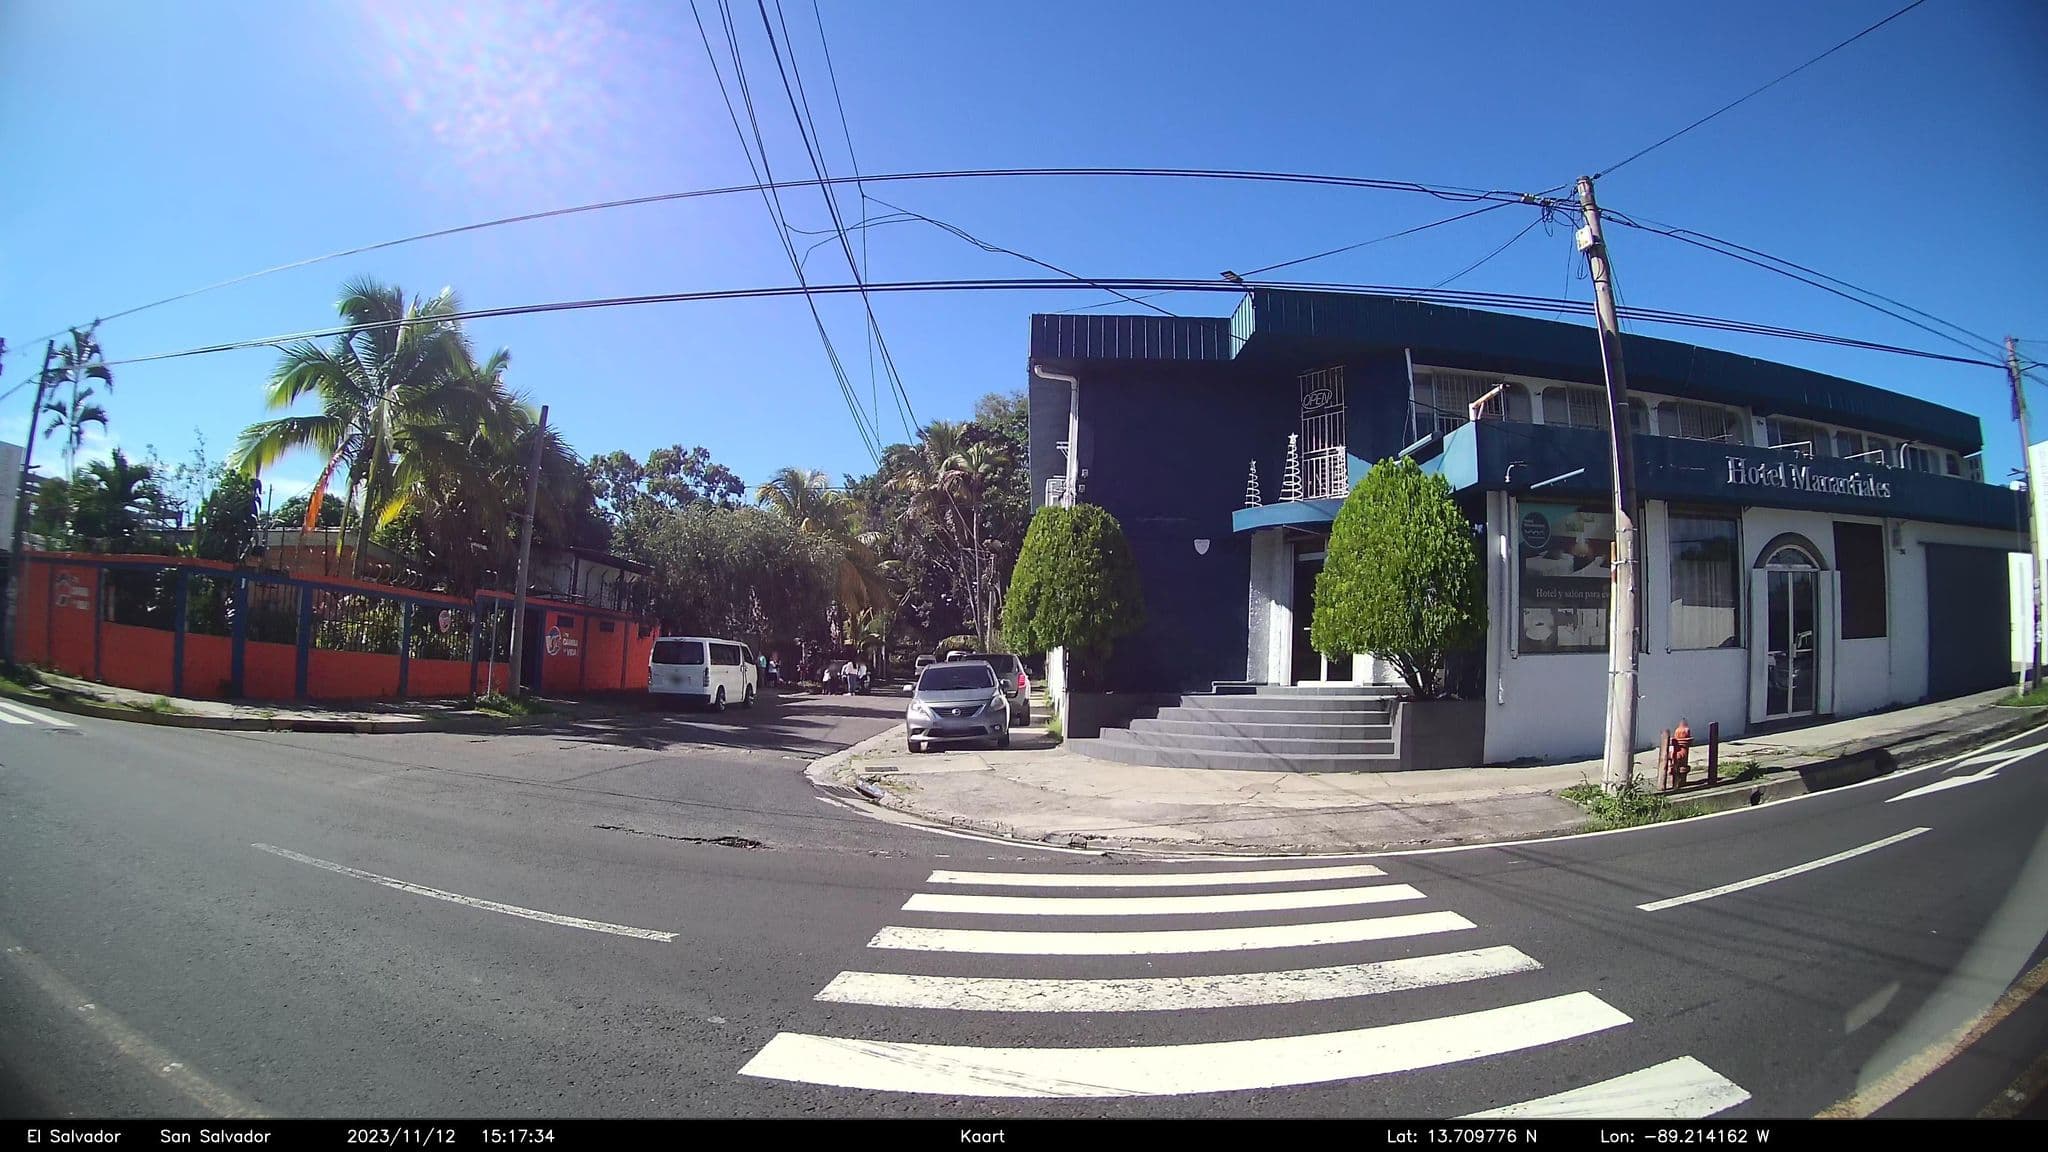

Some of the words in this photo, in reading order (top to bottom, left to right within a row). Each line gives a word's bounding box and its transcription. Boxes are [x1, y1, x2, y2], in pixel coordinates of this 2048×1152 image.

[1303, 392, 1329, 407] OPEN
[1725, 456, 1788, 488] Hotel
[1789, 463, 1891, 498] Manantiales
[1536, 588, 1557, 598] Hotel
